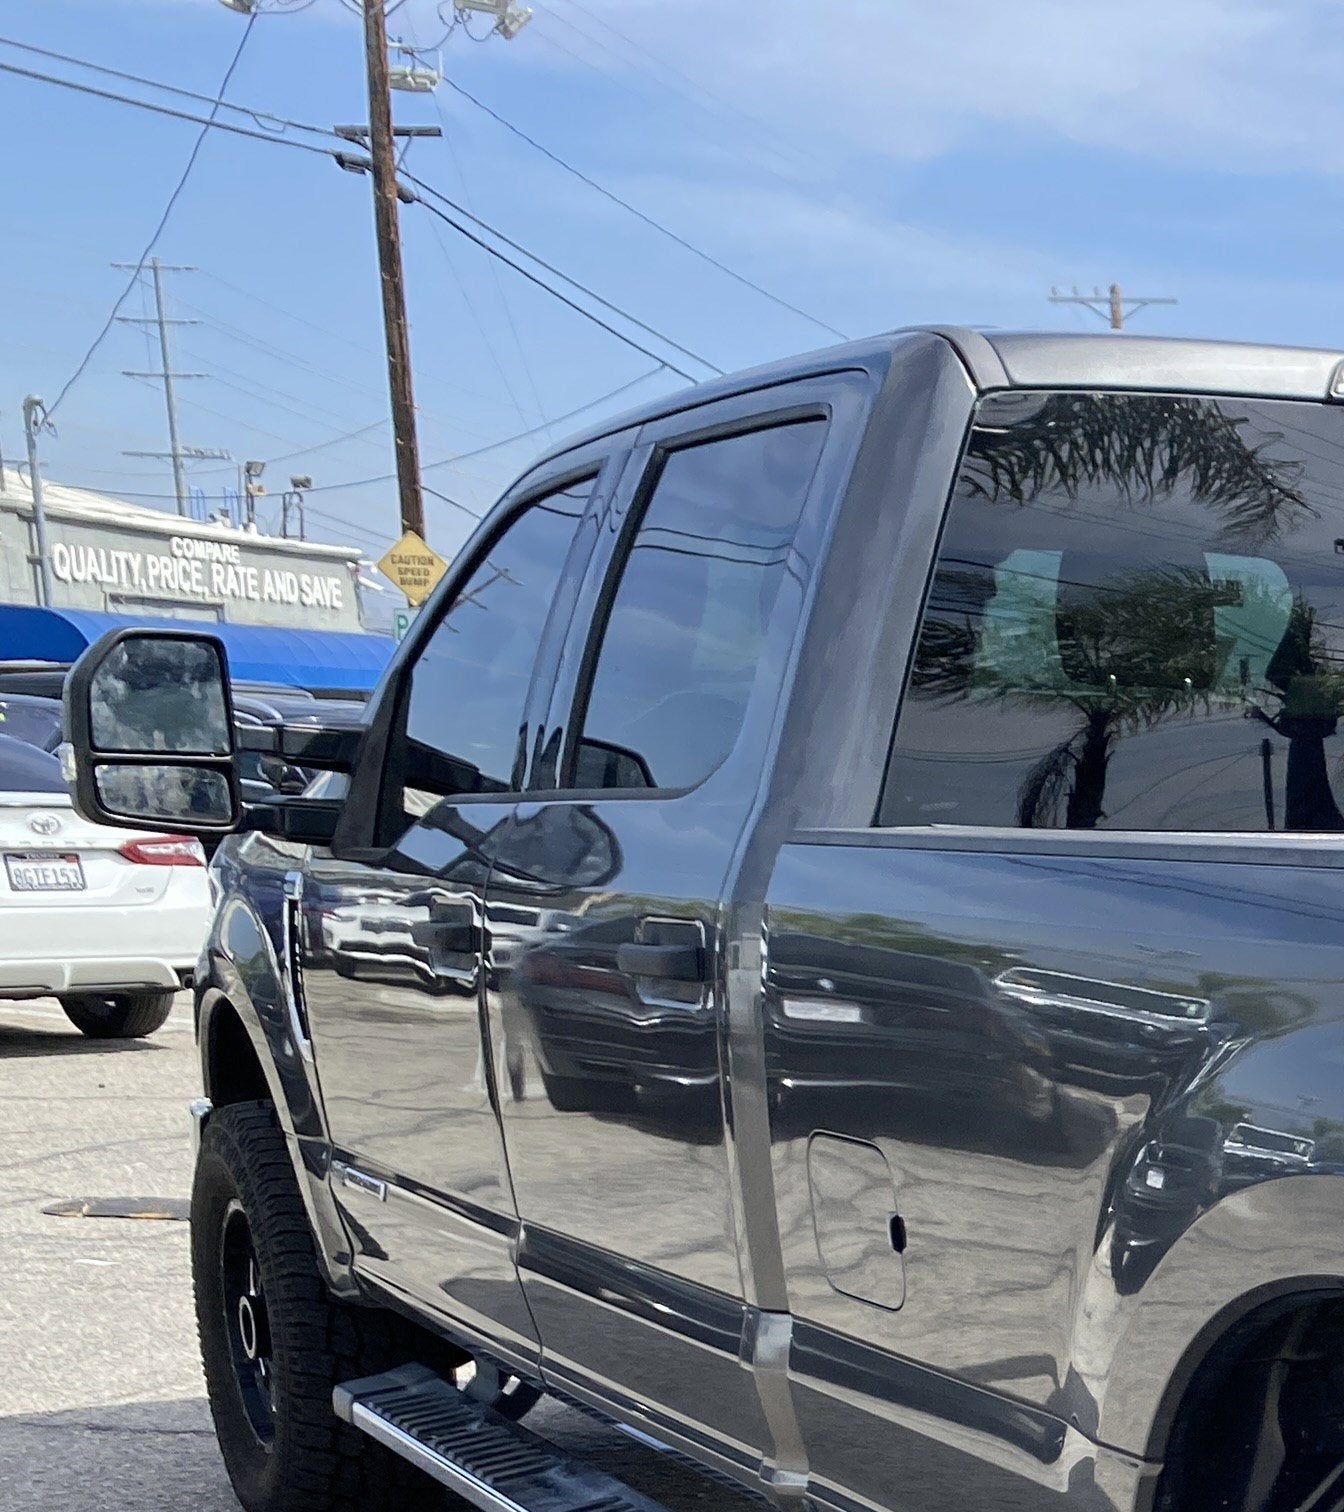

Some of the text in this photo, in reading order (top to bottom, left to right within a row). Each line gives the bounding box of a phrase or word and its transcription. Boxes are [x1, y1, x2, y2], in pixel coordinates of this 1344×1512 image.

[170, 537, 241, 565] COMPARE
[390, 554, 434, 566] CAUTION
[52, 542, 343, 609] QUALITY, PRICE, RATE AND SAVE
[397, 567, 430, 576] SPEED
